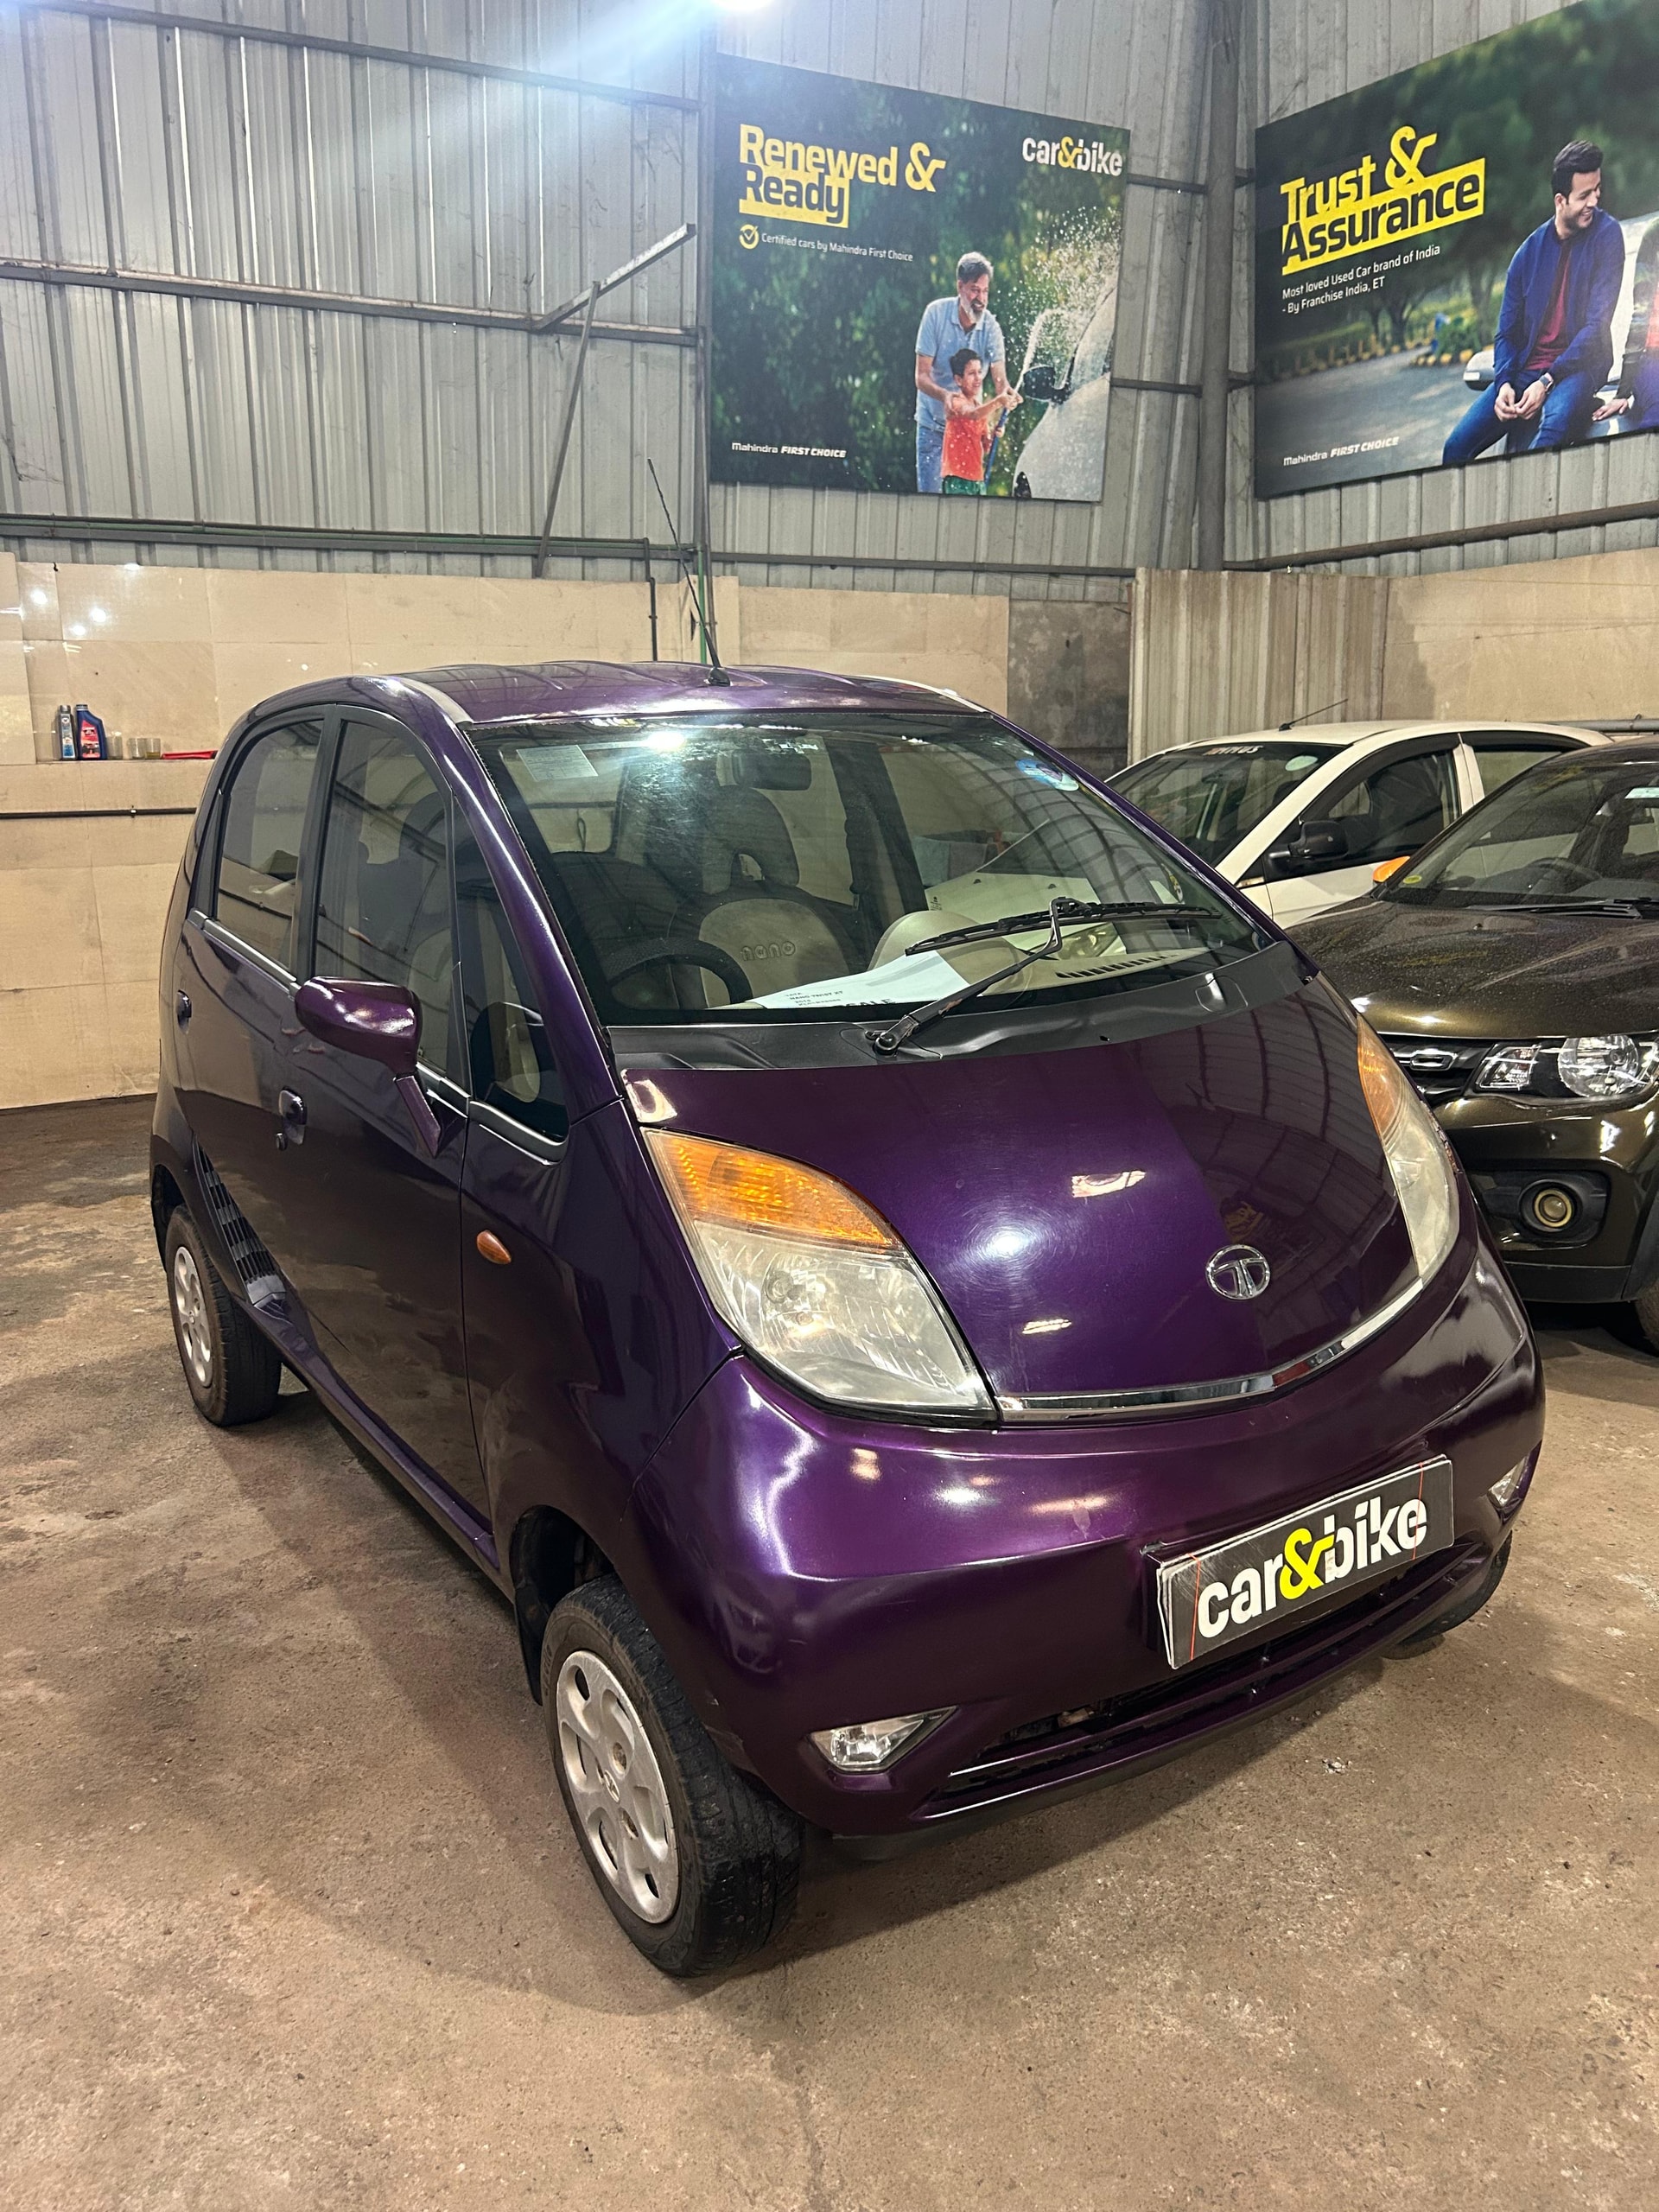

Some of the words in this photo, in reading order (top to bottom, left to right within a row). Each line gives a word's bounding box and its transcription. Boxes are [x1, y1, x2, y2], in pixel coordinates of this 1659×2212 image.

[740, 124, 898, 187] Renewed
[905, 142, 946, 193] &
[1022, 136, 1123, 176] car&bike
[1280, 155, 1376, 224] Trust
[1385, 125, 1437, 189] &
[741, 164, 845, 225] Ready
[1282, 174, 1480, 266] Assurance
[761, 232, 797, 246] Certified
[798, 239, 816, 250] cars
[817, 240, 828, 253] by
[829, 242, 868, 256] Mahindra
[868, 247, 887, 258] First
[887, 250, 913, 262] Choice
[1282, 285, 1304, 300] Most
[1306, 276, 1330, 292] loved
[1331, 269, 1354, 285] Used
[1356, 265, 1371, 278] Car
[1373, 257, 1402, 273] brand
[1402, 251, 1414, 264] of
[1415, 244, 1440, 261] India
[1287, 302, 1300, 315] By
[1301, 289, 1344, 309] Franchise
[1345, 281, 1371, 297] India,
[1372, 276, 1385, 289] ET
[732, 442, 779, 454] Mahindra
[780, 445, 810, 456] FIRST
[810, 448, 847, 459] CHOICE
[1283, 451, 1328, 467] Mahindra
[1330, 443, 1361, 458] FIRST
[1360, 436, 1400, 452] CHOICE
[742, 941, 796, 961] nano
[1197, 1496, 1427, 1638] car&bike
